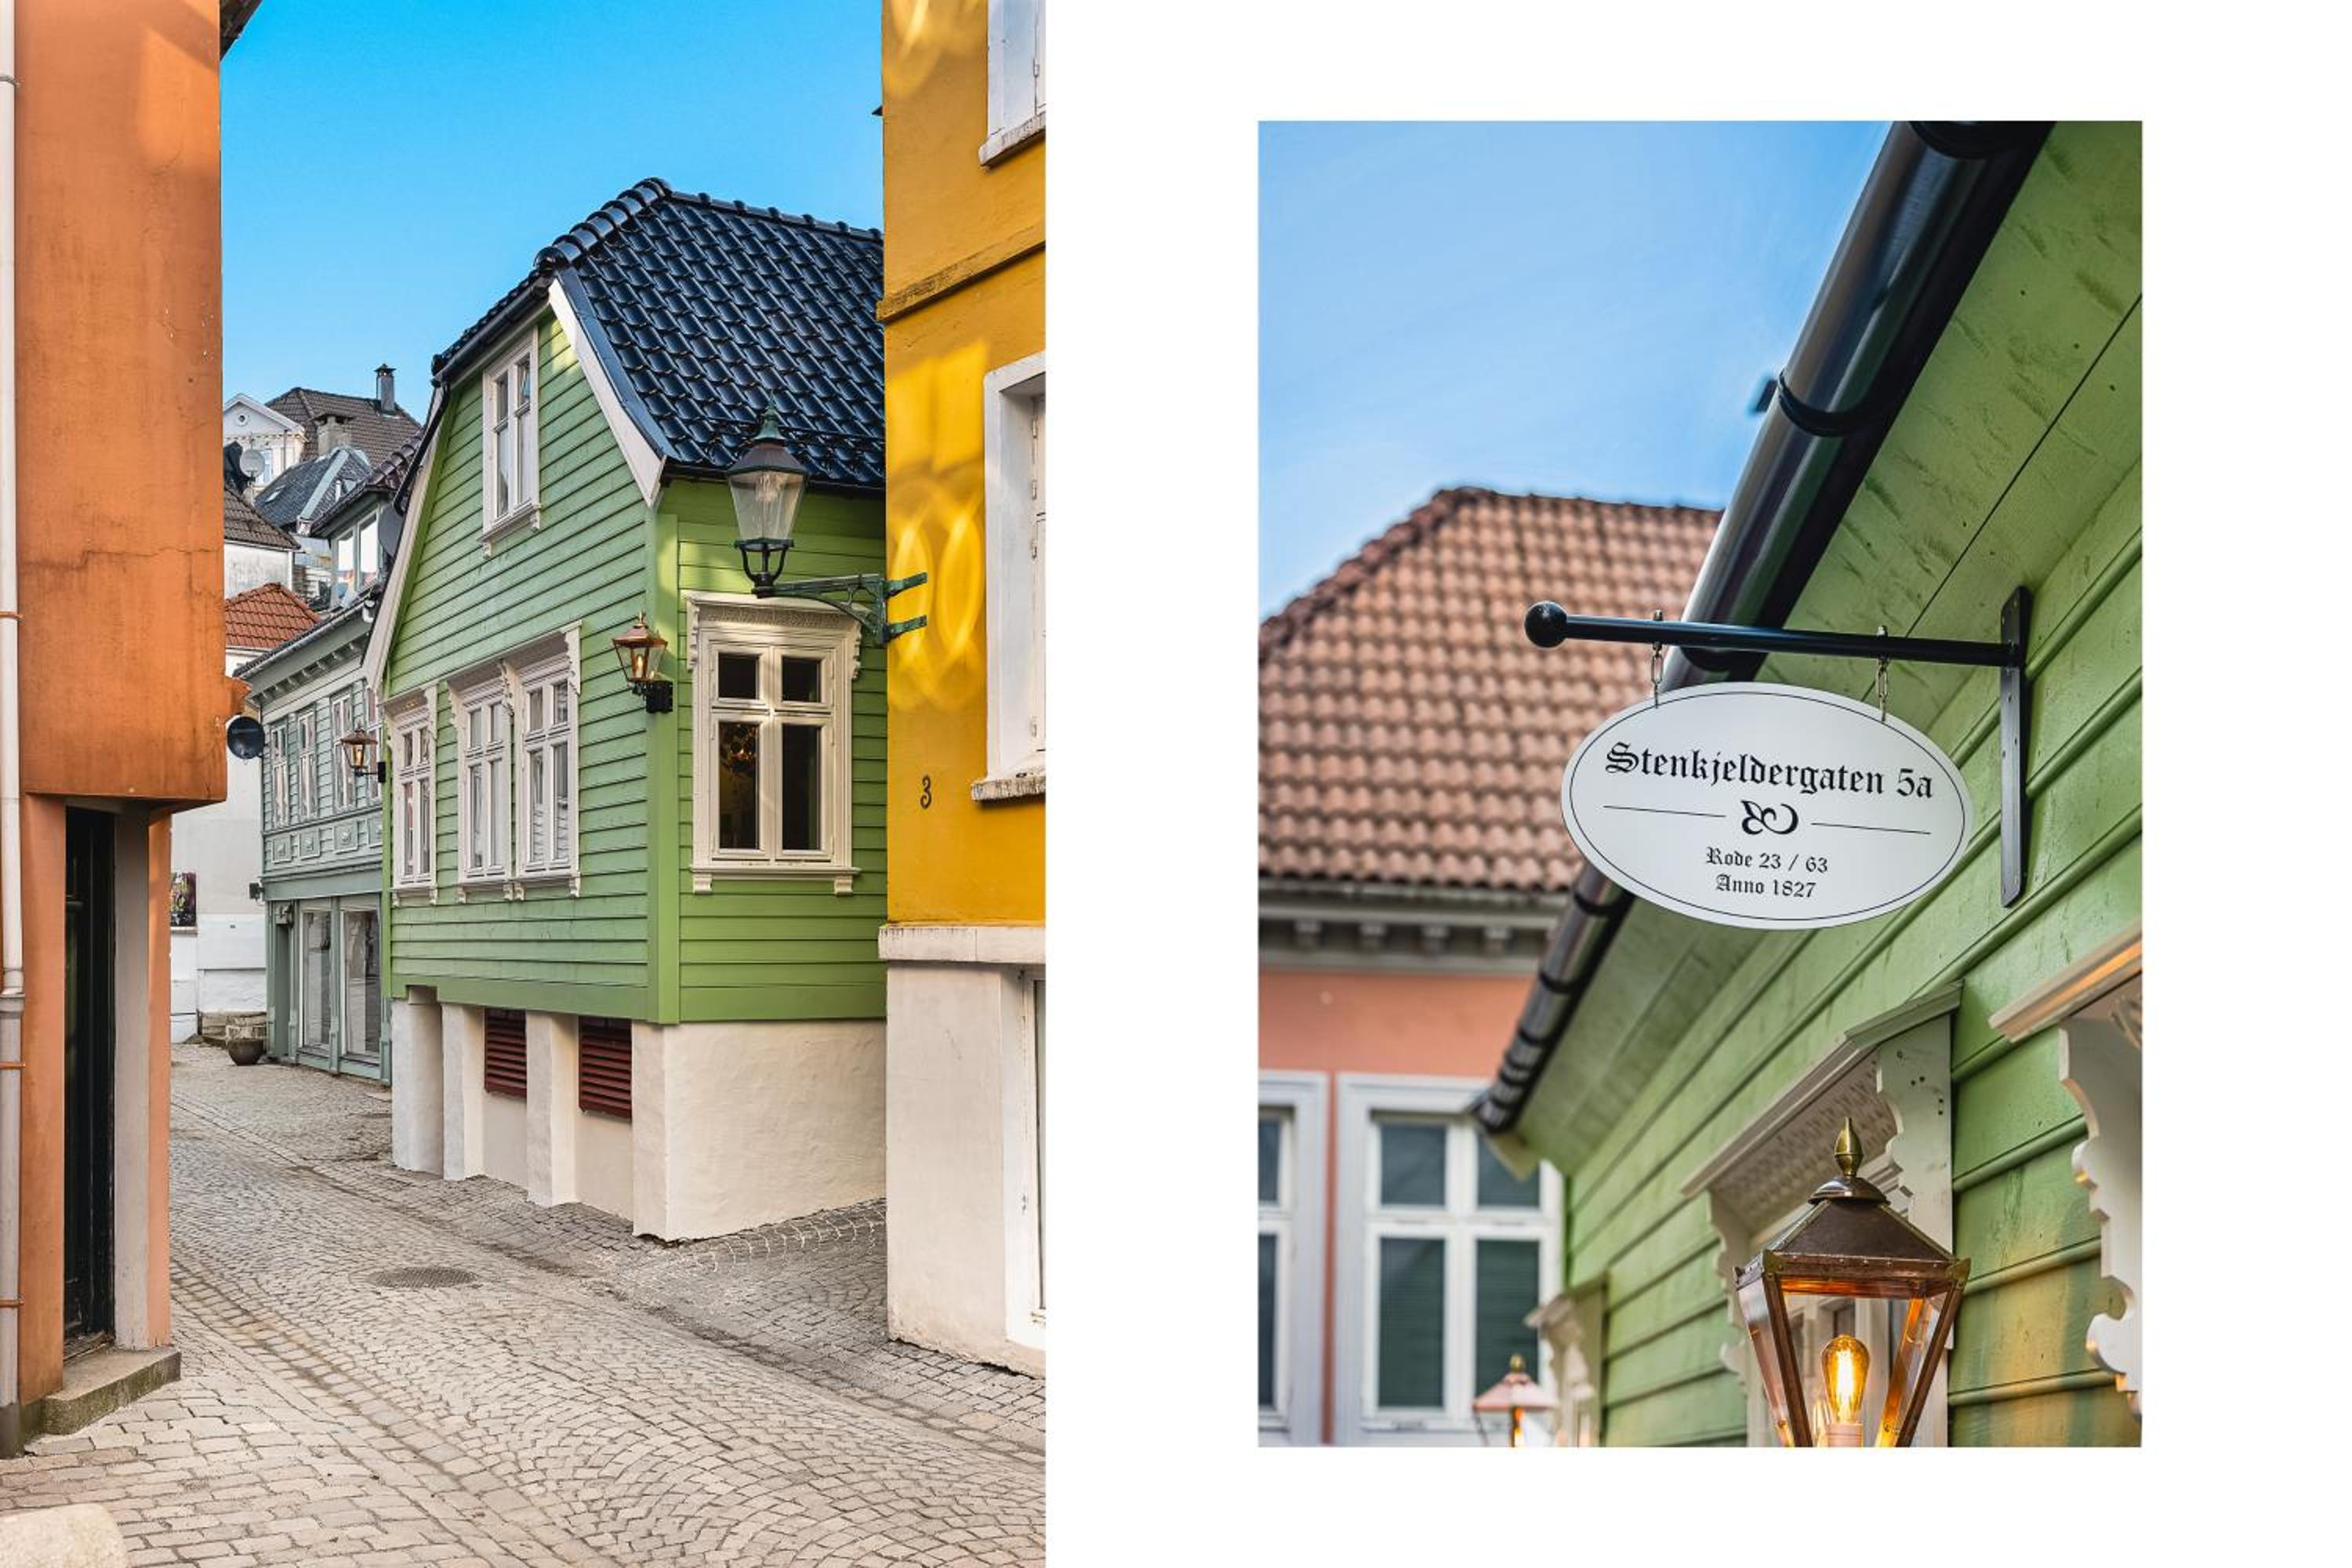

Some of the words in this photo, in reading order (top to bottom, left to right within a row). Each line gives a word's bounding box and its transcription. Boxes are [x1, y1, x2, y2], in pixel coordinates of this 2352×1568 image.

[1605, 741, 1883, 795] Stenkjeldergaten
[1896, 768, 1933, 799] 5a
[920, 775, 932, 810] 3
[1706, 847, 1753, 867] Rode
[1759, 852, 1781, 869] 23
[1788, 854, 1799, 871] /
[1806, 856, 1828, 873] 63
[1716, 873, 1765, 895] Anno
[1773, 879, 1817, 898] 1827
